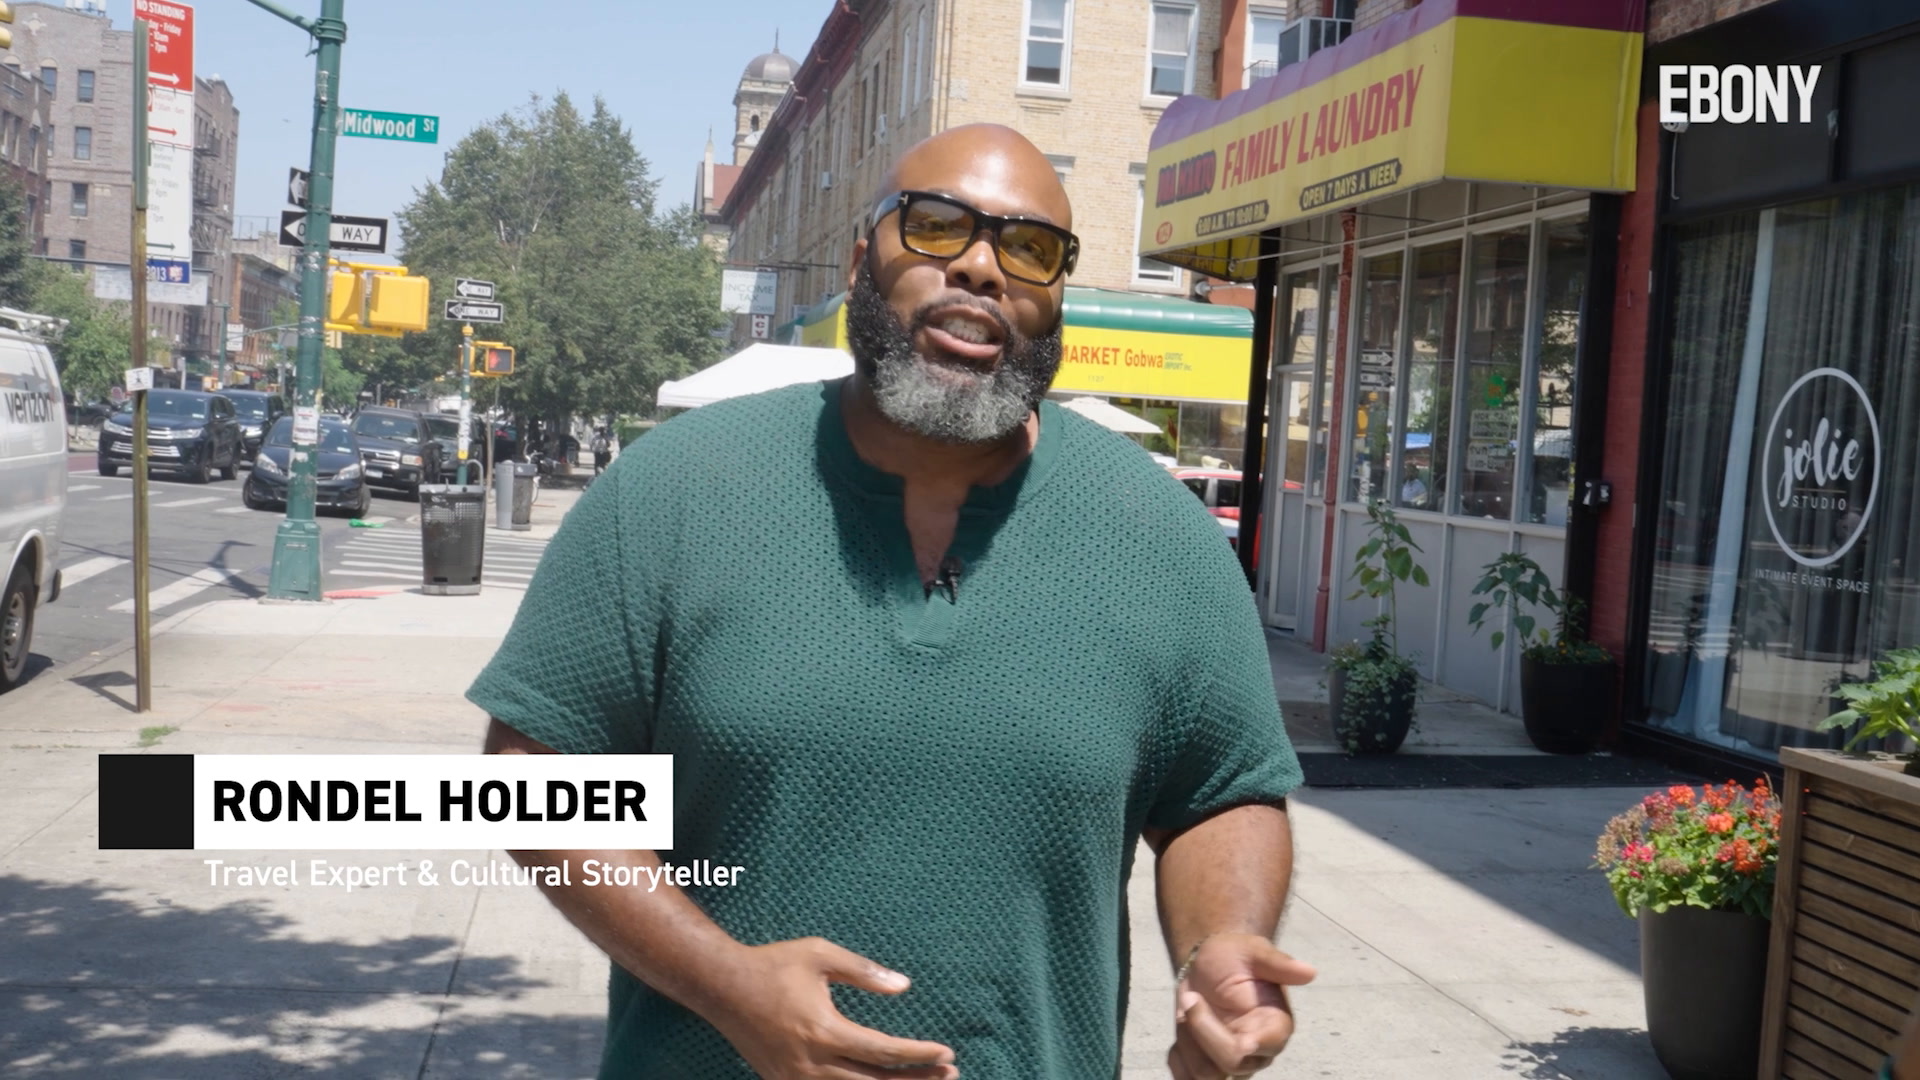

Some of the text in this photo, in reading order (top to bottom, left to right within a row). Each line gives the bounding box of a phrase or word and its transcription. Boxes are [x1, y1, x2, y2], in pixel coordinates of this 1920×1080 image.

[136, 0, 186, 20] NO STANDING
[163, 22, 182, 37] Friday
[154, 42, 168, 54] 7pm
[345, 112, 435, 138] Midwood St
[1221, 116, 1295, 190] FAMILY
[1297, 64, 1424, 164] LAUNDRY
[1302, 161, 1398, 209] OPEN 7 DAYS A WEEK
[1226, 210, 1236, 228] TO
[342, 226, 374, 242] WAY
[725, 283, 774, 294] INCOME
[739, 293, 759, 303] TAX
[454, 306, 469, 314] ONE
[1125, 349, 1163, 369] Gobwa
[5, 384, 55, 424] verizon
[1777, 417, 1864, 508] jolie
[1792, 495, 1847, 511] STUDIO
[1755, 568, 1870, 594] INTIMATE EVENT SPACE
